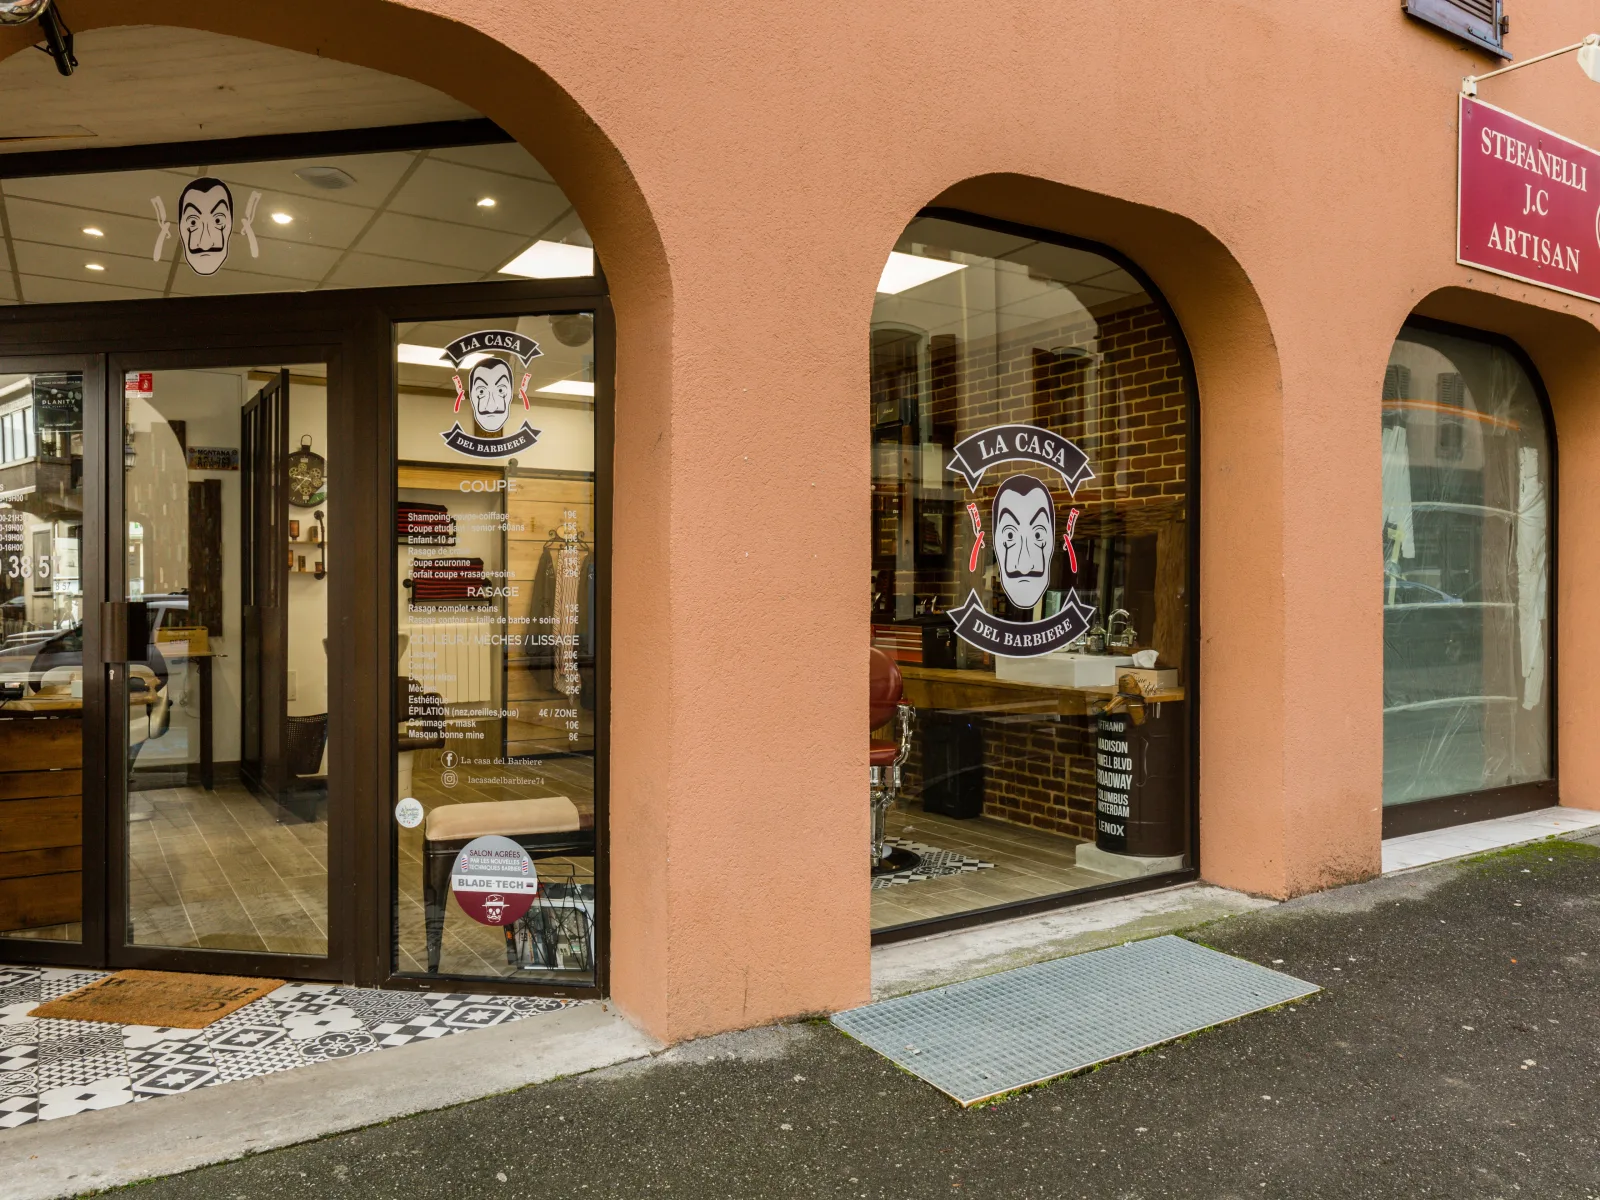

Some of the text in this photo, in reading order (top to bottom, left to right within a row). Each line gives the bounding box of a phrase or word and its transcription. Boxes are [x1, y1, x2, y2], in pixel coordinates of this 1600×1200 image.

[1481, 127, 1587, 192] STEFANELLI
[1523, 183, 1548, 216] J.C
[1487, 222, 1580, 274] ARTISAN
[459, 334, 521, 353] LA CASA
[456, 435, 526, 453] DEL BARBIERE
[977, 432, 1065, 468] LA CASA
[459, 479, 517, 493] COUPE
[408, 524, 433, 534] Coupe
[408, 535, 433, 544] Enfant
[434, 535, 447, 544] -10
[408, 546, 437, 557] Rasage
[8, 555, 33, 578] 38
[408, 558, 433, 568] Coupe
[434, 559, 471, 567] couronne
[408, 569, 433, 577] Forfait
[434, 571, 458, 579] coupe
[467, 586, 520, 598] RASAGE
[408, 604, 437, 614] Rasage
[437, 604, 469, 614] complet
[477, 603, 499, 612] soins
[408, 615, 437, 625] Rasage
[496, 615, 507, 624] de
[508, 615, 531, 624] barbe
[539, 615, 560, 624] soins
[972, 618, 1073, 648] DEL BARBIERE
[531, 634, 580, 646] LISSAGE
[563, 650, 578, 660] 20€
[564, 662, 578, 671] 25€
[565, 674, 579, 683] 30€
[565, 685, 580, 695] 25€
[408, 695, 448, 706] Esthétique
[408, 705, 450, 716] ÉPILATION
[539, 708, 549, 718] 4€
[554, 708, 578, 718] ZONE
[408, 718, 447, 729] Gommage
[455, 719, 477, 728] mask
[565, 720, 579, 730] 10€
[408, 729, 579, 741] Masque bonne mine 8€
[460, 756, 472, 765] La
[493, 757, 505, 765] del
[507, 757, 543, 766] Barbiere
[1113, 756, 1132, 771] BLVD
[467, 775, 545, 785] lacasadelbarbiere74
[1098, 819, 1125, 837] LENOX
[469, 849, 521, 858] SALON AGRÉES
